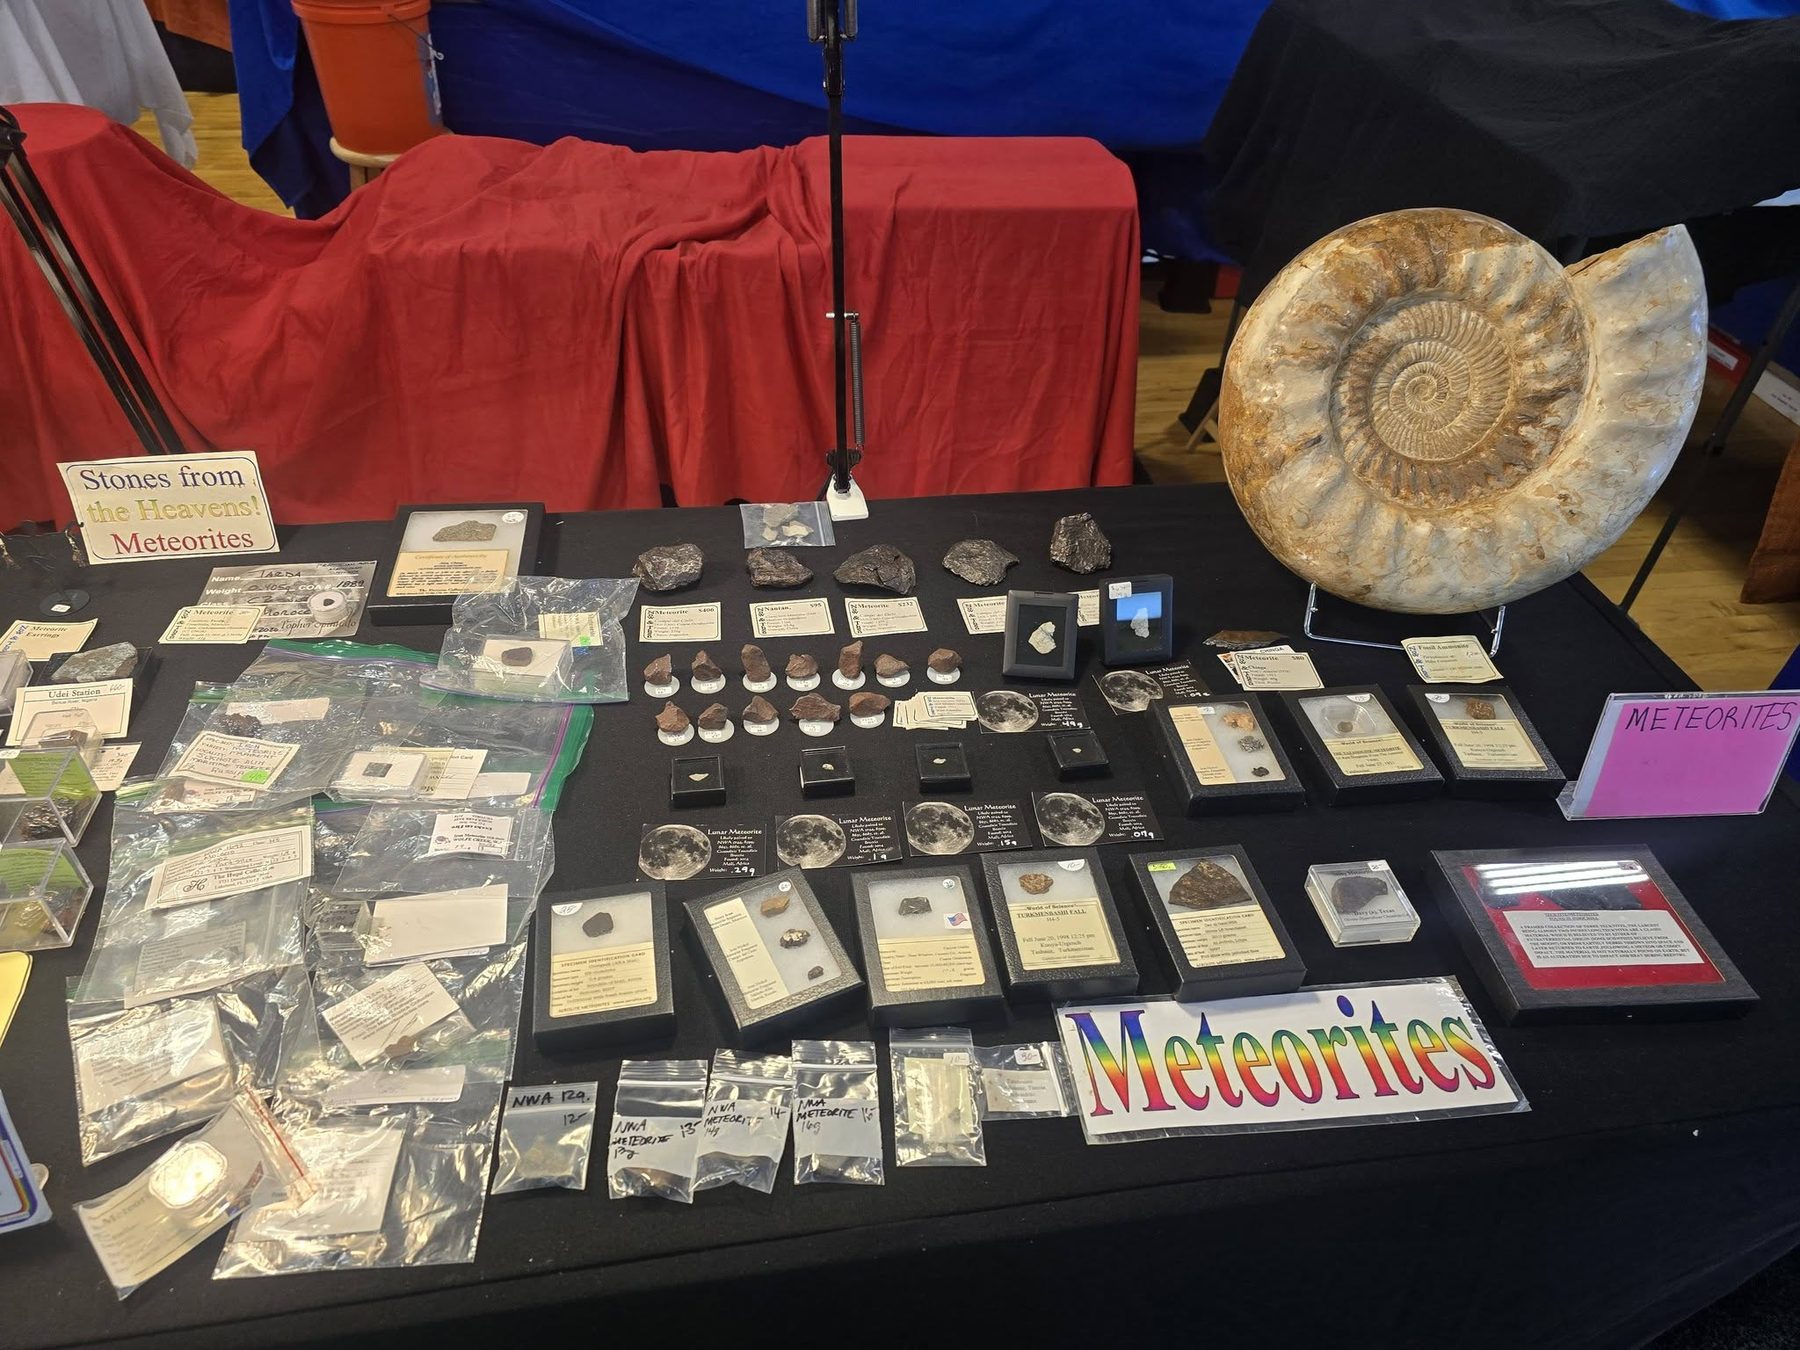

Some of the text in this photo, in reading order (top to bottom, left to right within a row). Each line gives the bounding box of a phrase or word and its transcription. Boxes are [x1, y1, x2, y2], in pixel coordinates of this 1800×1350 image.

[80, 465, 245, 490] Stones from
[87, 495, 261, 523] the Heavens!
[110, 528, 254, 555] Meteorites
[206, 587, 242, 596] Weight
[48, 690, 69, 698] Udei
[72, 688, 101, 696] Station
[1625, 702, 1797, 732] METEORITES
[1017, 910, 1068, 919] TURKMENBASHI
[1064, 995, 1496, 1116] Meteorites
[512, 1091, 554, 1108] NWA
[798, 1099, 826, 1111] NWA
[707, 1102, 736, 1115] NWA
[796, 1108, 859, 1122] METEORITE
[614, 1119, 647, 1134] NWA
